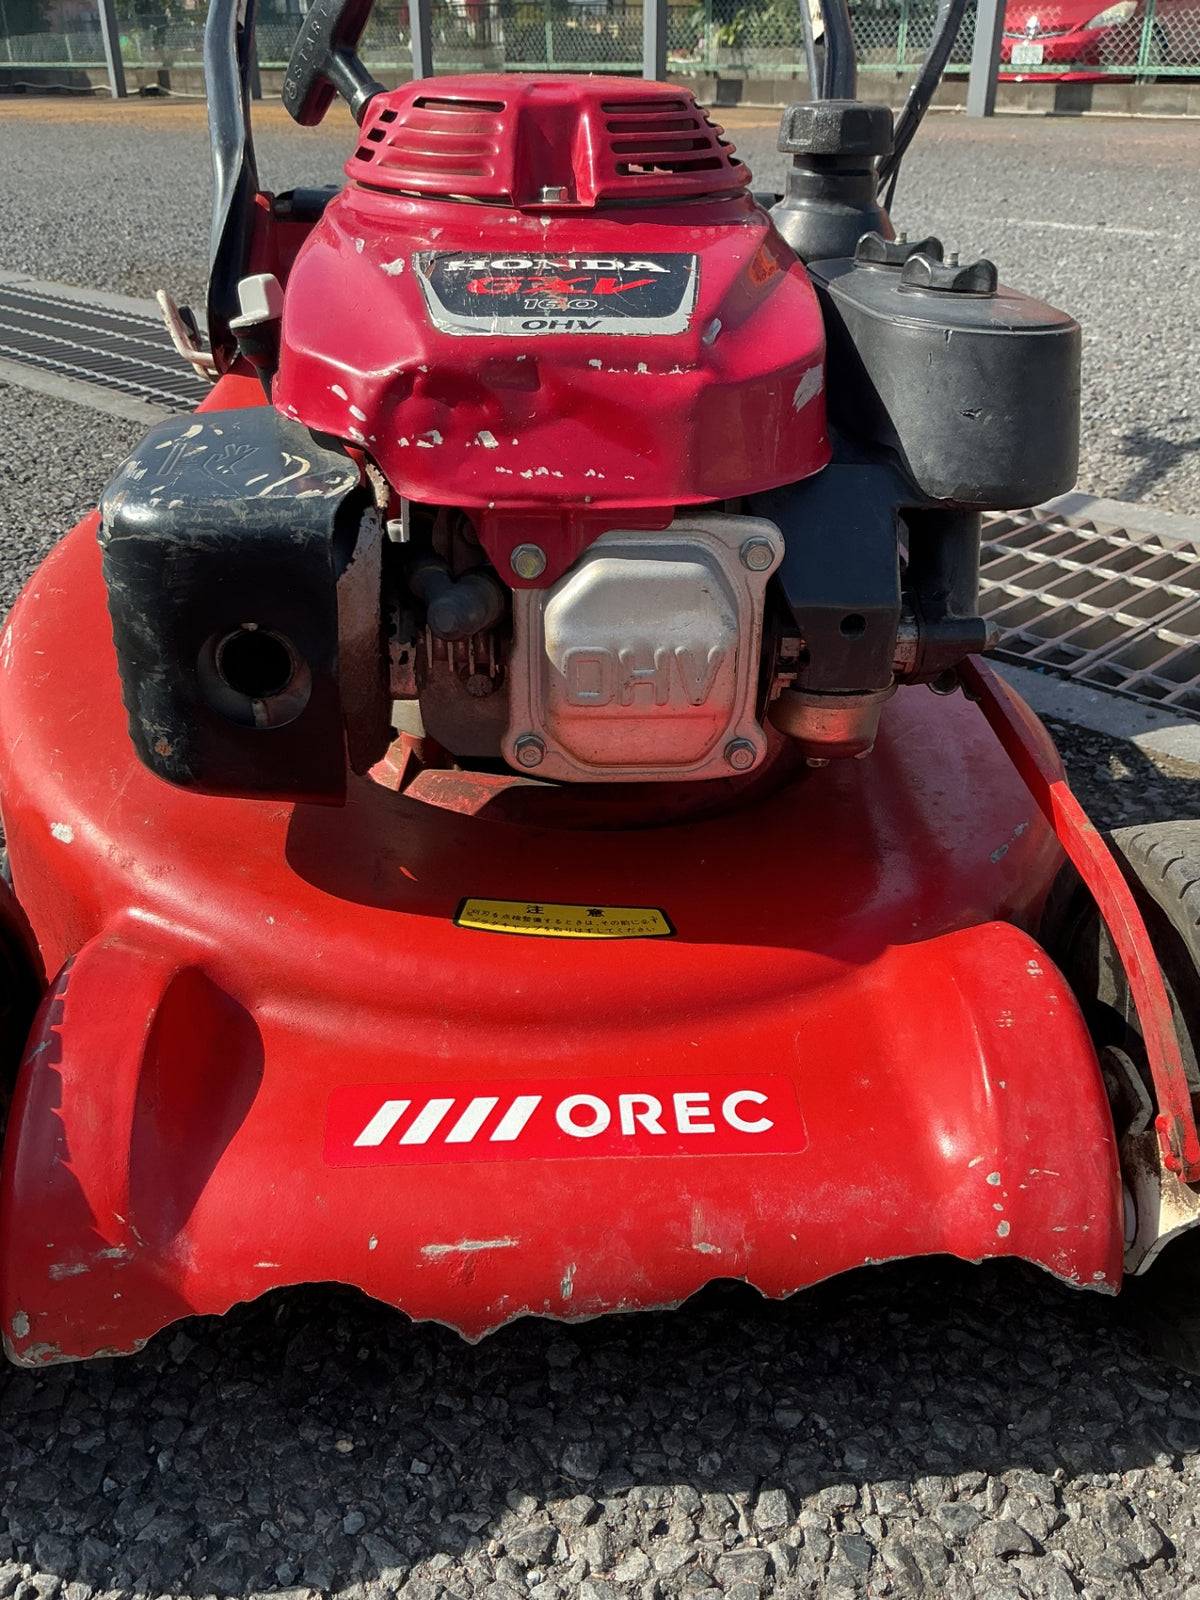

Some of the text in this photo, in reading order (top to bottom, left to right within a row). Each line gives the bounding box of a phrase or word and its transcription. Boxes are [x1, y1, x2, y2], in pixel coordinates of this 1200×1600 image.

[294, 3, 328, 79] START
[443, 259, 671, 273] HONDA
[466, 276, 657, 295] GXV
[524, 298, 598, 310] 160
[521, 320, 602, 330] OHV
[562, 646, 726, 706] OHV
[555, 1090, 775, 1138] OREC
